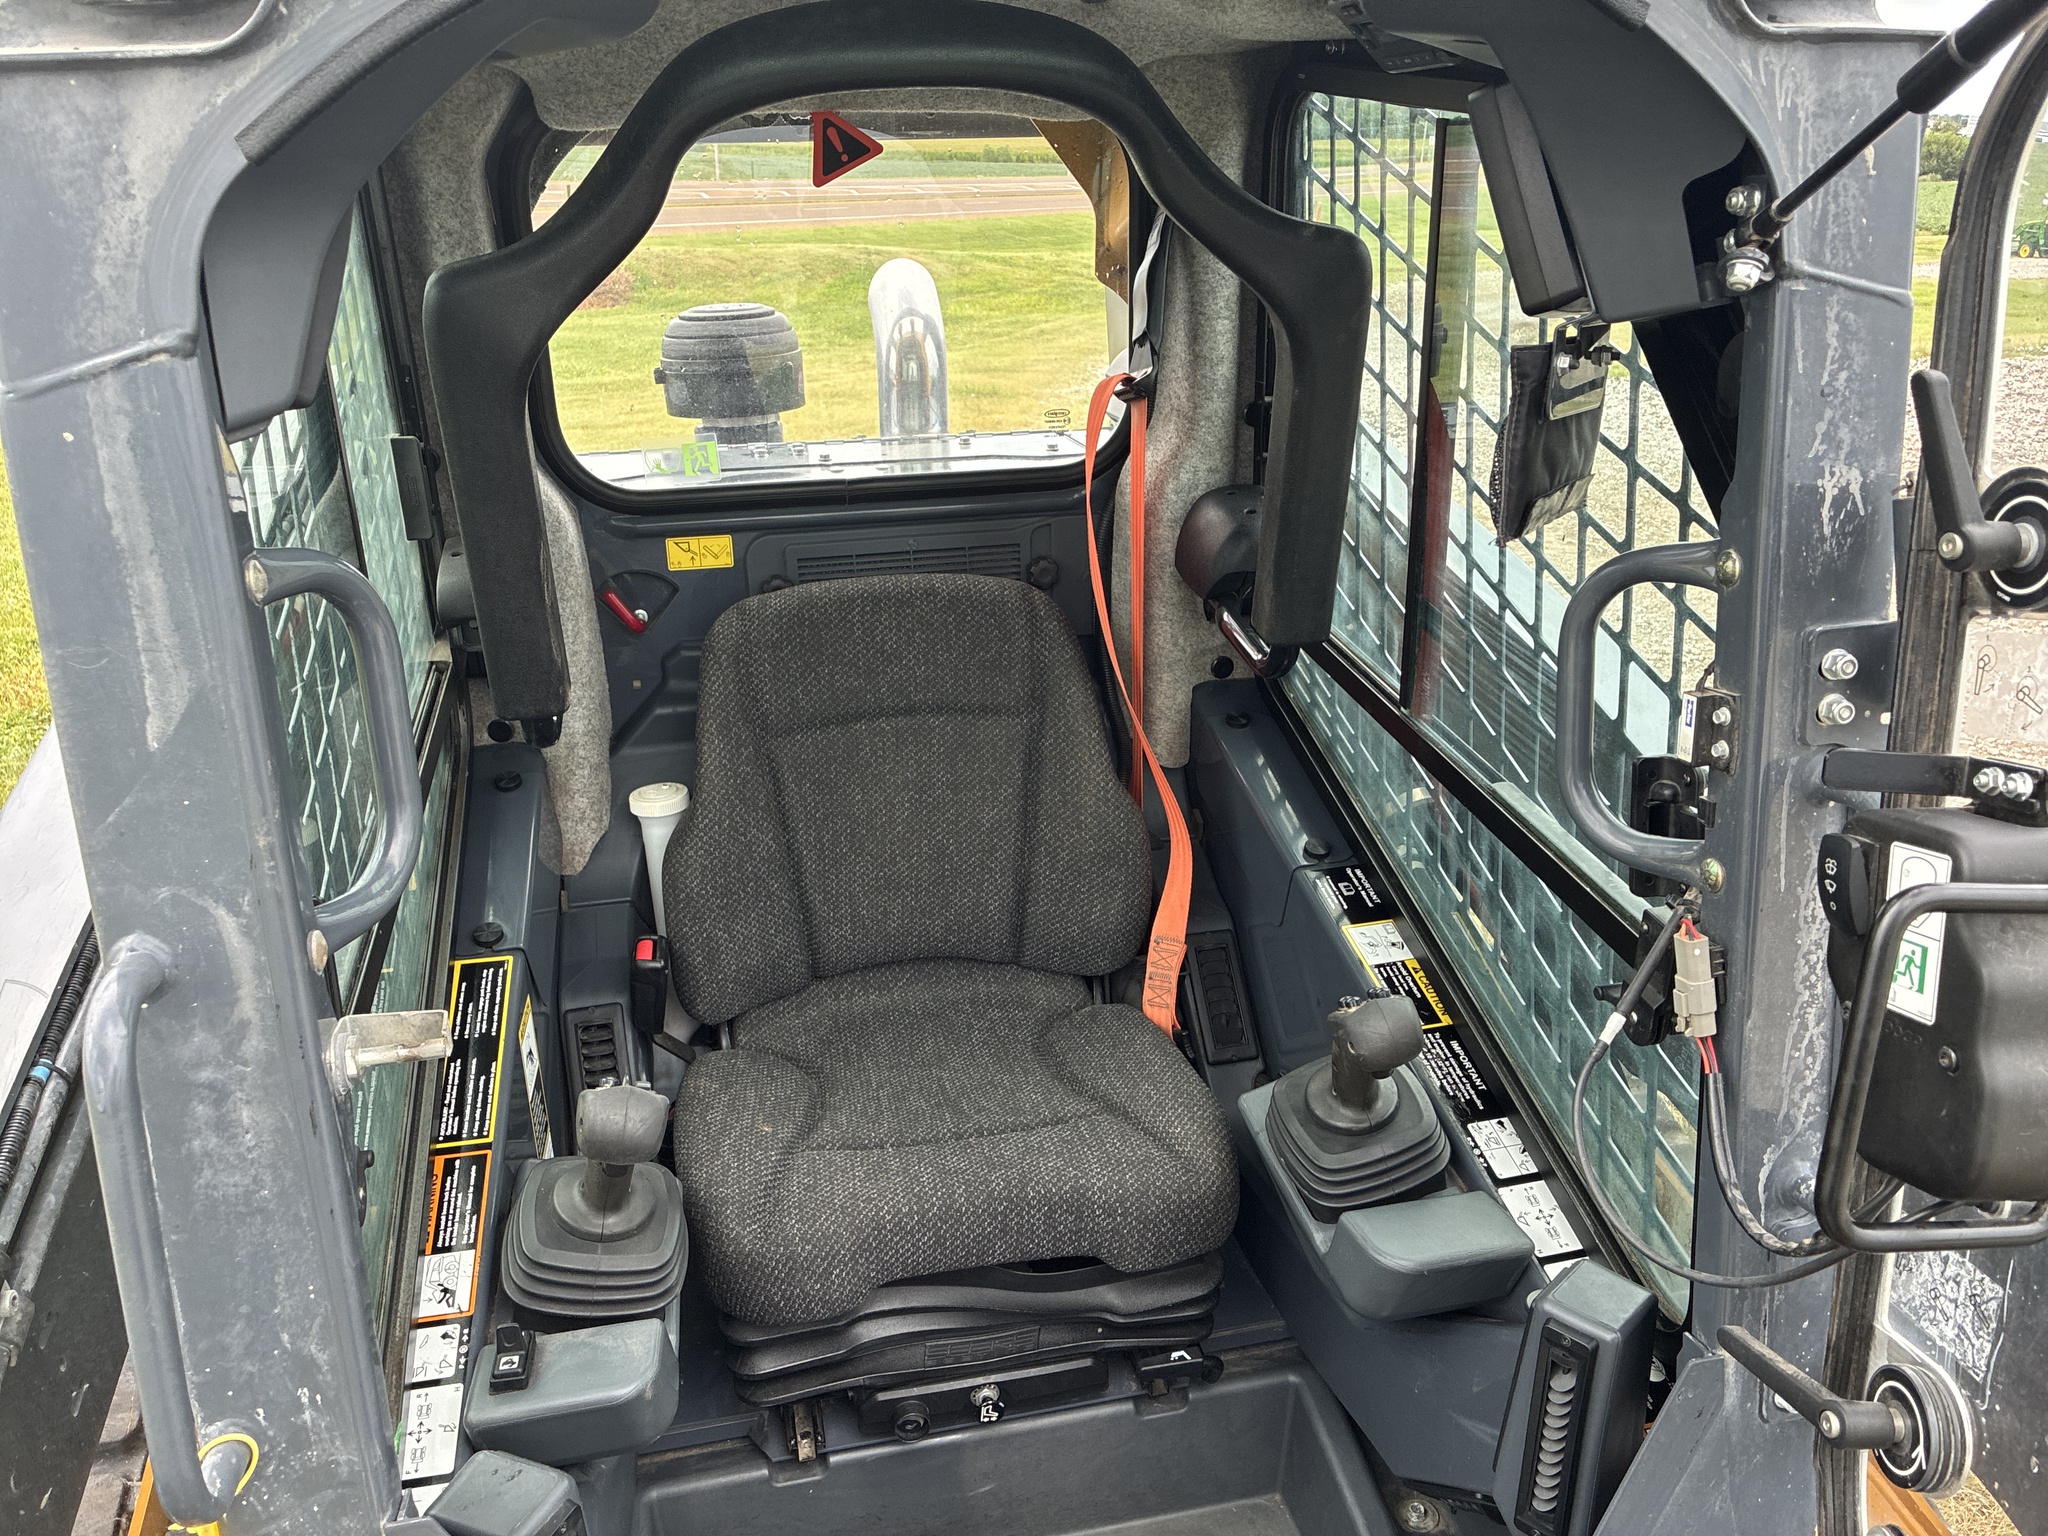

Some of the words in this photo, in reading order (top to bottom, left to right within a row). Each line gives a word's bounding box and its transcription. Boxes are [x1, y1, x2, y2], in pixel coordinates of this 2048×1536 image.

[1354, 868, 1381, 903] IMPORTANT
[1418, 976, 1448, 1016] CAUTION
[1450, 1040, 1487, 1090] IMPORTANT
